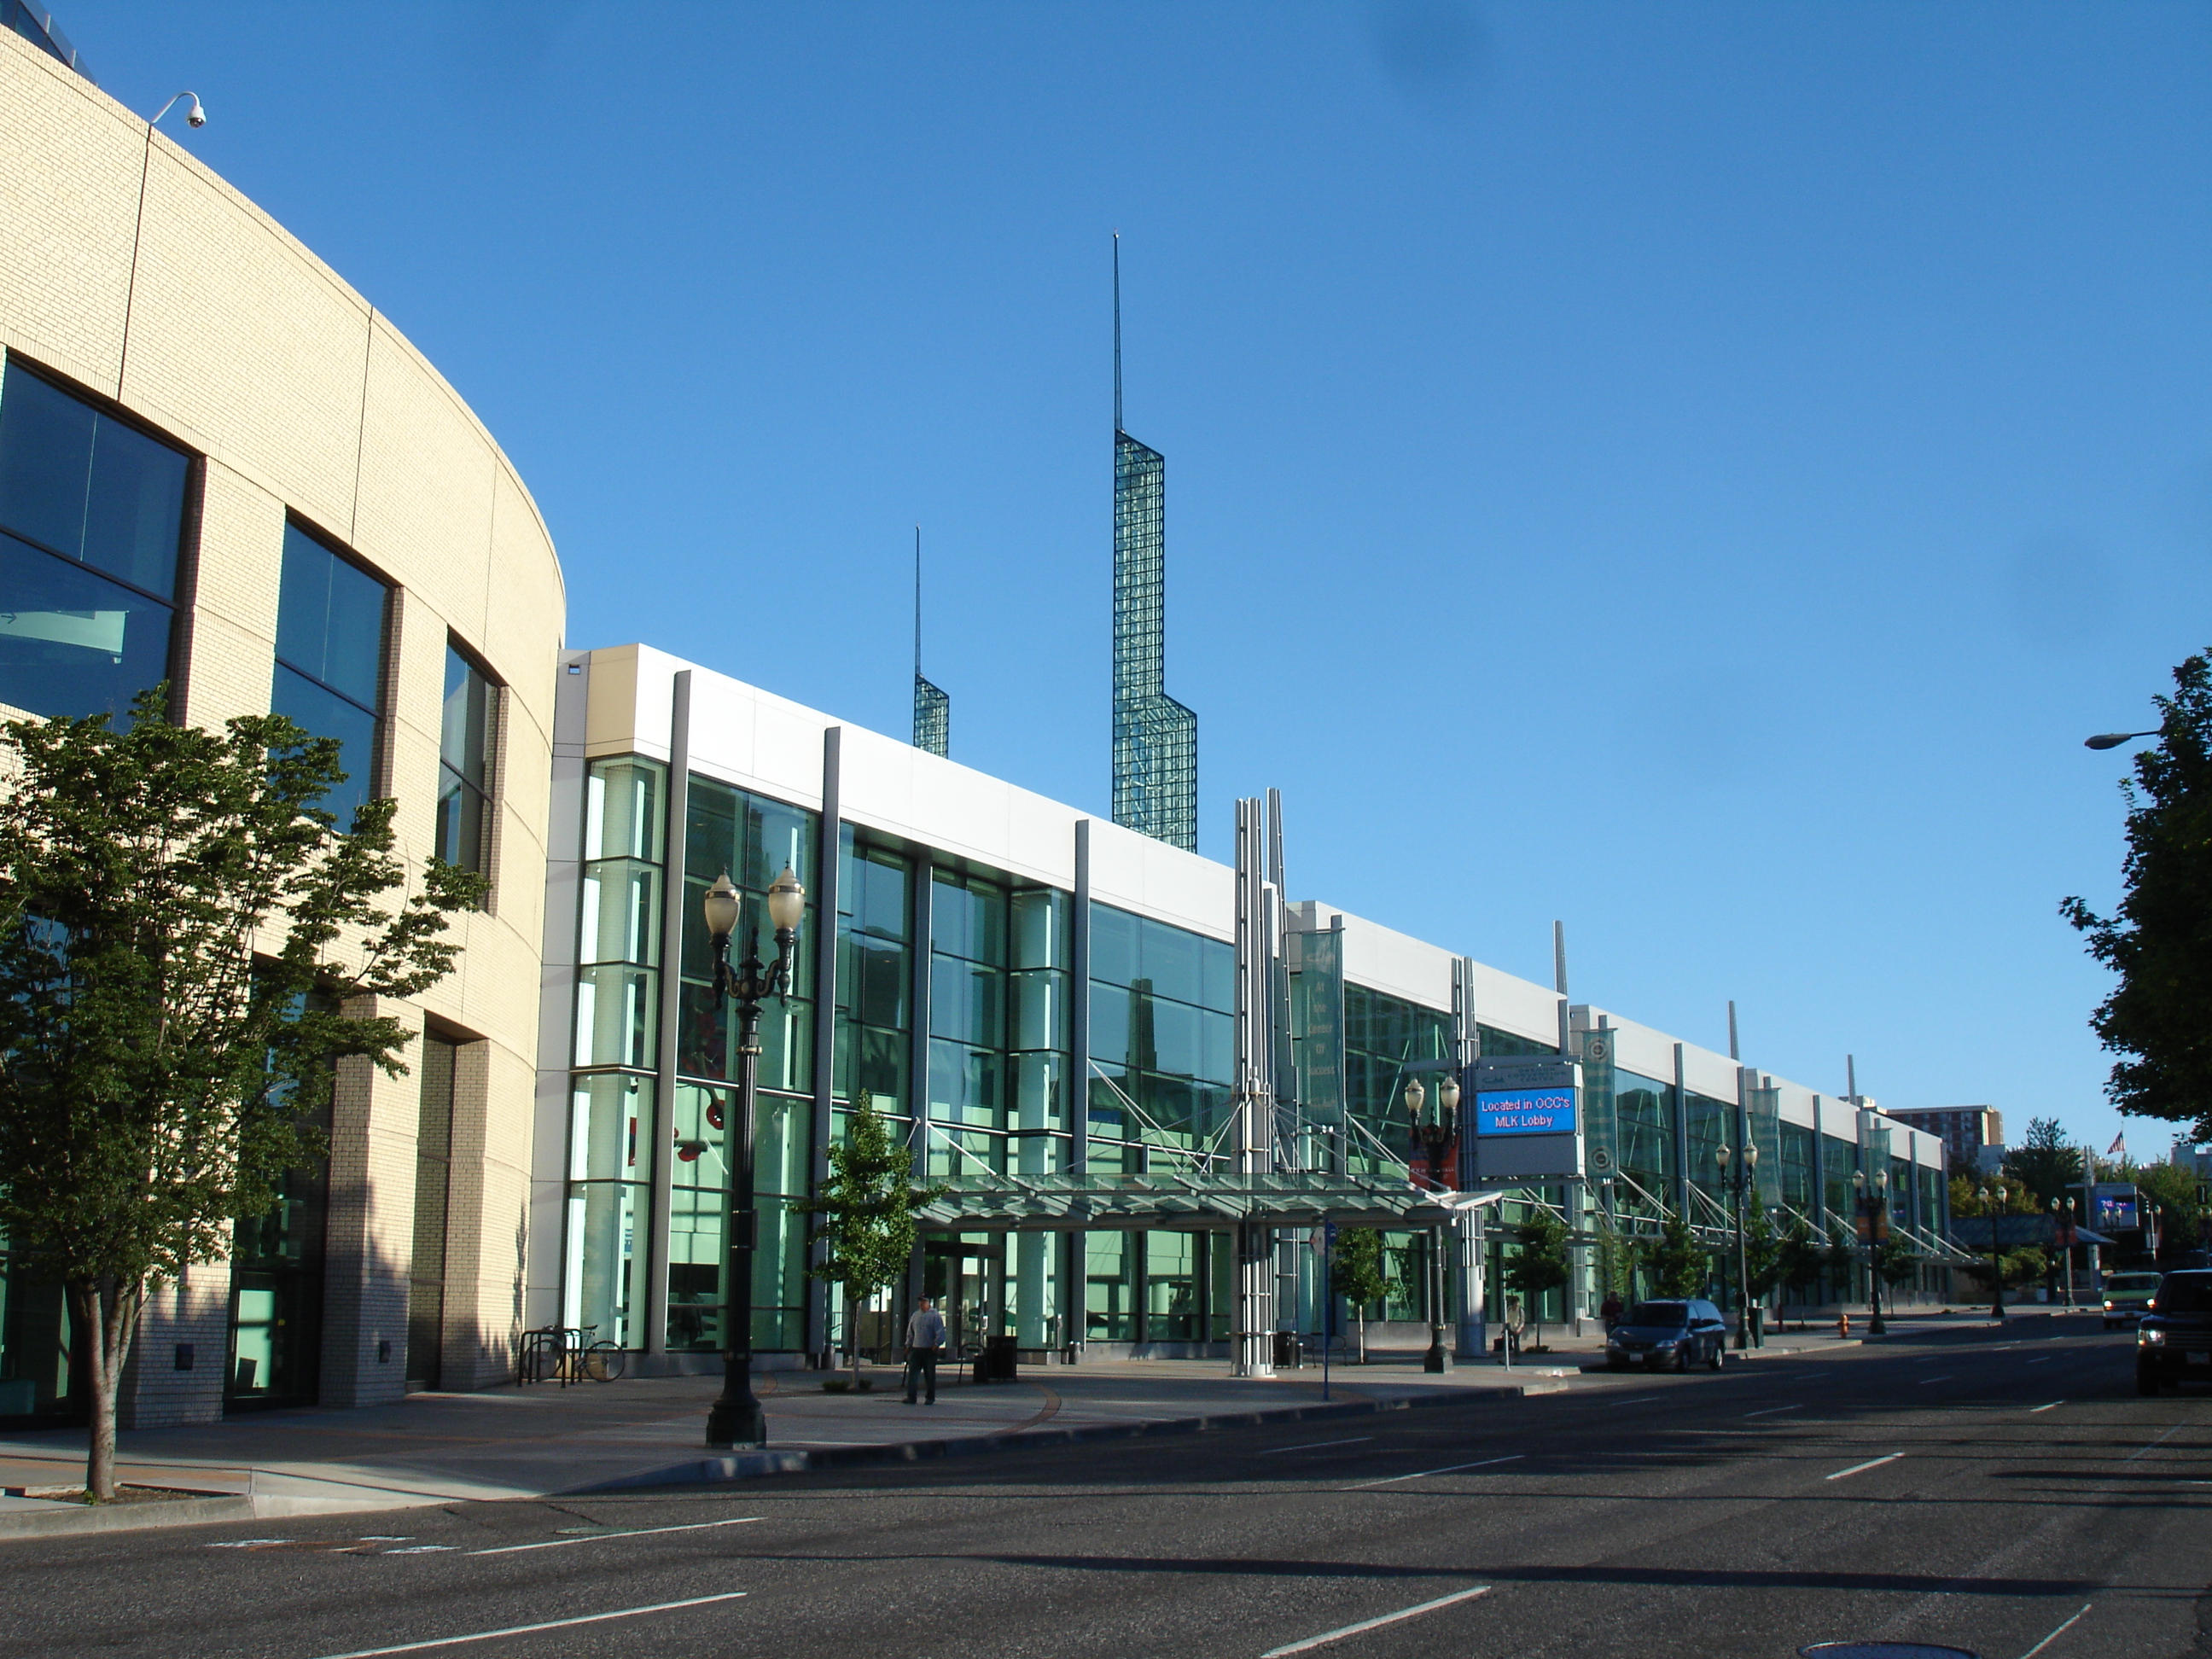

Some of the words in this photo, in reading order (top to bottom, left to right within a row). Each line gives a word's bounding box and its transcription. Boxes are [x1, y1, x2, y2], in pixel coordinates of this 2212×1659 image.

[1481, 1098, 1521, 1112] Located
[1523, 1098, 1533, 1110] in
[1495, 1115, 1518, 1128] MLK
[1522, 1115, 1554, 1128] Lobby
